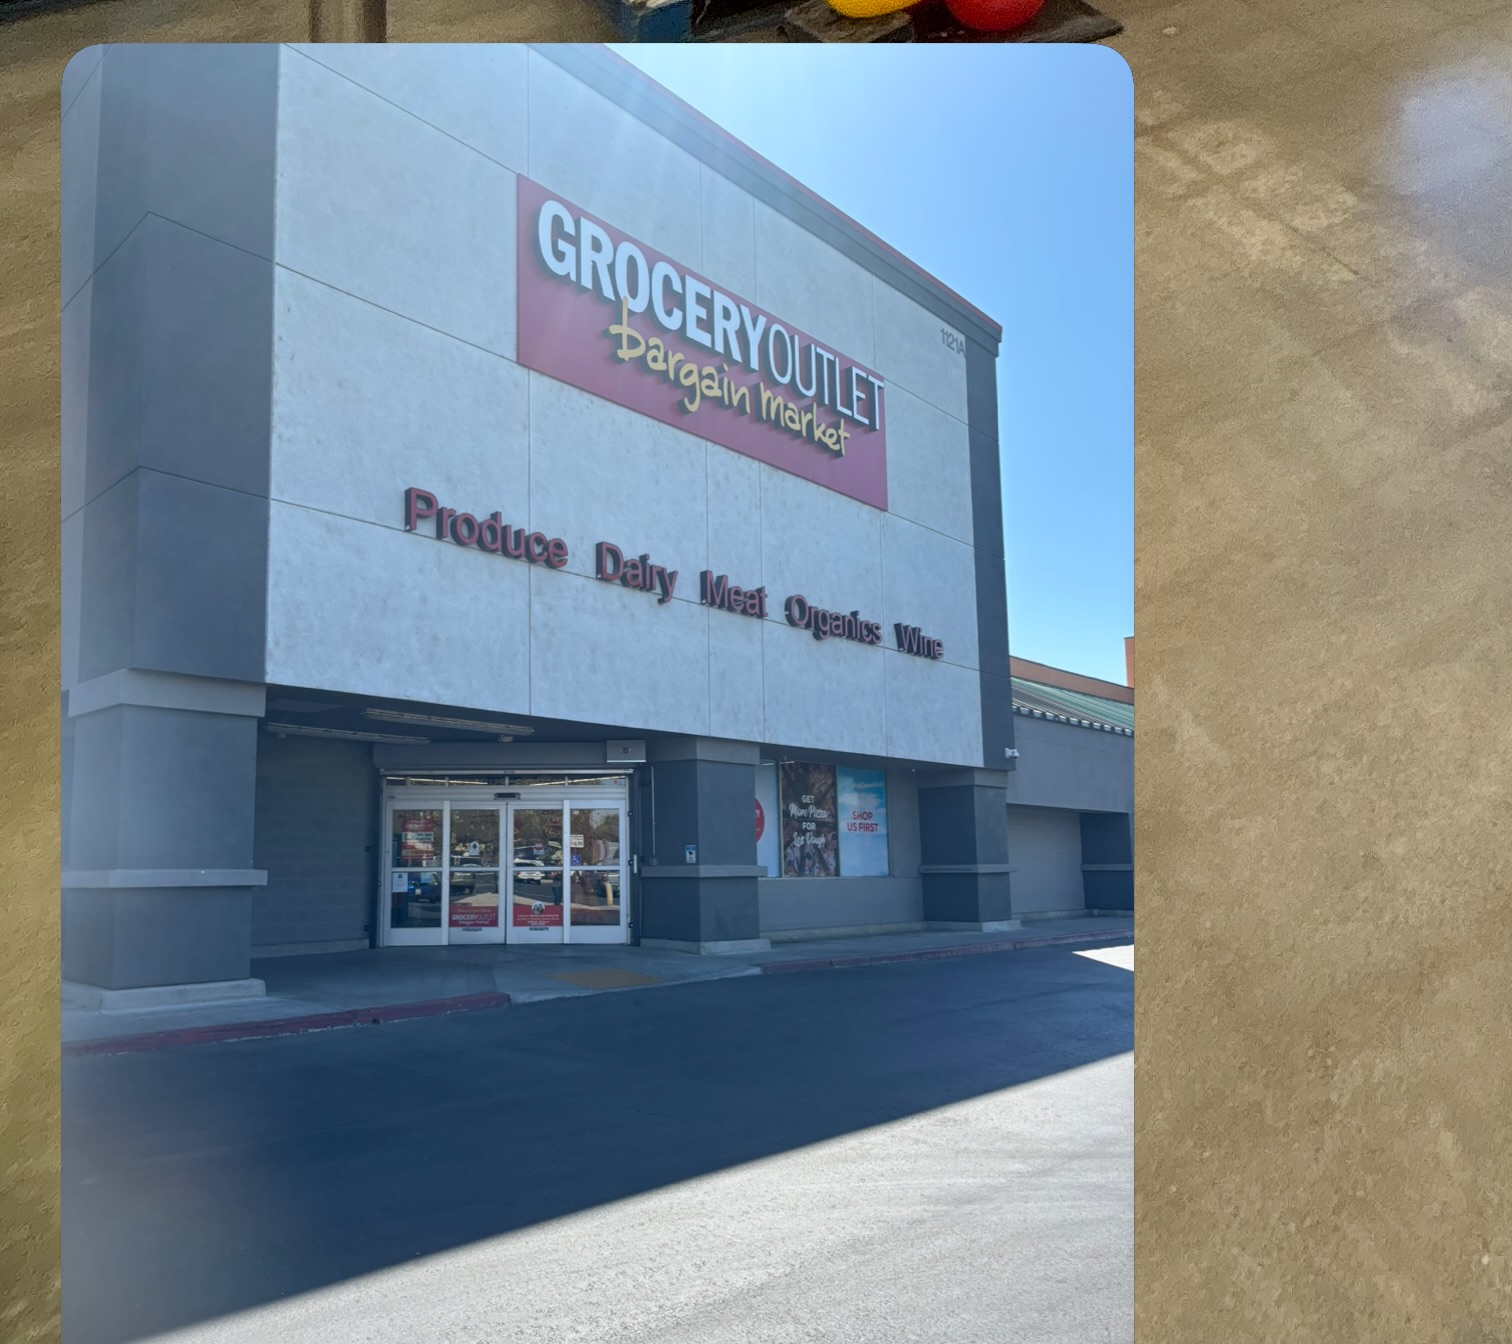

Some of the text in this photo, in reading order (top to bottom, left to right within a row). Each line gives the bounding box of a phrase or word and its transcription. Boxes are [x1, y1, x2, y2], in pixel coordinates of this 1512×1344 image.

[759, 382, 852, 458] market
[404, 486, 945, 660] Produce Dairy Meat Organics Wine
[802, 795, 815, 804] GET
[807, 804, 830, 819] Pizza
[852, 811, 873, 821] SHOP
[802, 822, 816, 830] FOR
[847, 822, 879, 833] US FIRST
